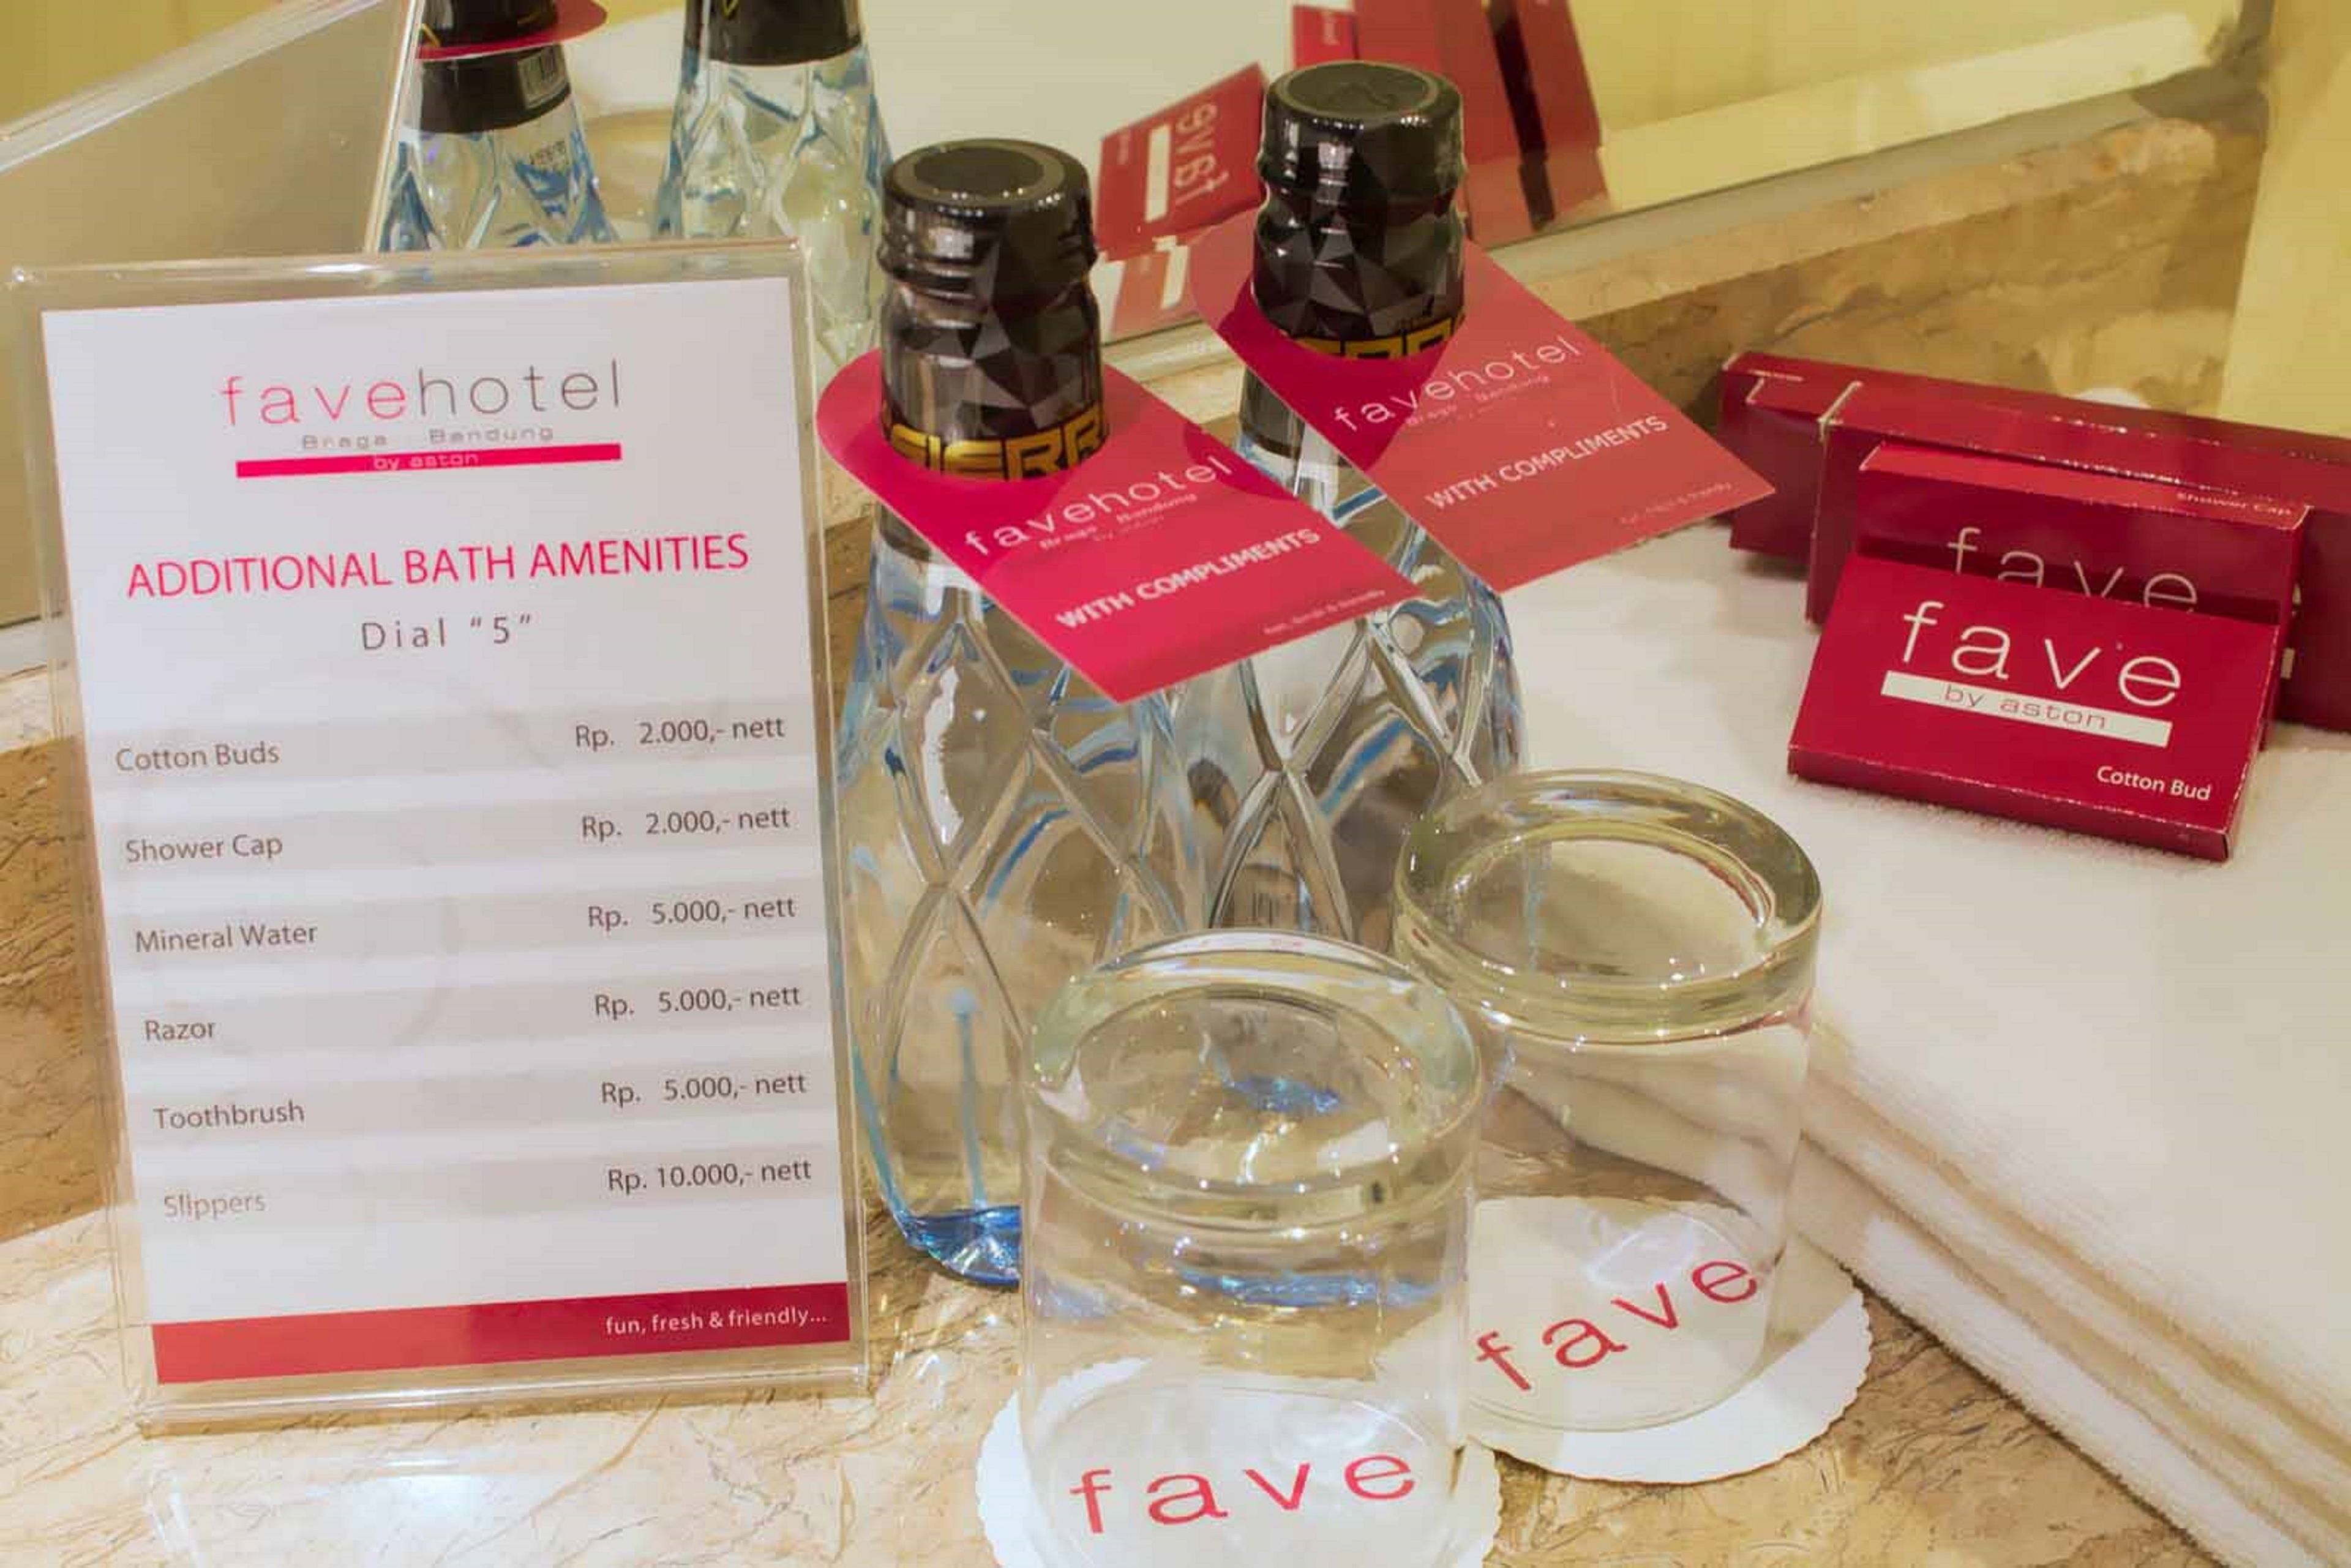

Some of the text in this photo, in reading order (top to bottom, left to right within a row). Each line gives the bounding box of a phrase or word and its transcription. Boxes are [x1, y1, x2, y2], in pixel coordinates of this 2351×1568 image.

[220, 358, 620, 426] favehotel
[1335, 335, 1581, 431] favehotel
[303, 426, 553, 450] Braga Bandung
[373, 453, 479, 471] by aston
[1425, 415, 1669, 509] WITH COMPLIMENTS
[965, 455, 1232, 555] favehotel
[127, 533, 749, 599] ADDITIONAL BATH AMENITIES
[1057, 591, 1134, 628] WITH
[1136, 528, 1321, 600] COMPLIMENTS
[1948, 527, 2198, 613] fave
[361, 617, 447, 651] Dial
[1903, 601, 2181, 707] fave
[1943, 684, 2107, 729] by aston
[116, 718, 786, 771] Cotton Buds Rp. 2.000,- nett
[2096, 765, 2211, 800] Cotton Bud
[126, 808, 791, 863] Shower Cap Rp. 2.000,- nett
[135, 898, 797, 953] Mineral Water Rp. 5.000,- nett
[144, 986, 801, 1041] Razor Rp. 5.000,- nett
[153, 1073, 807, 1130] Toothbrush Rp. 5.000,- nett
[163, 1160, 812, 1220] Slippers Rp. 10.000,- nett
[606, 1306, 828, 1336] fun, fresh & friendly...
[1475, 1259, 1758, 1393] fave
[1069, 1450, 1416, 1534] fave
